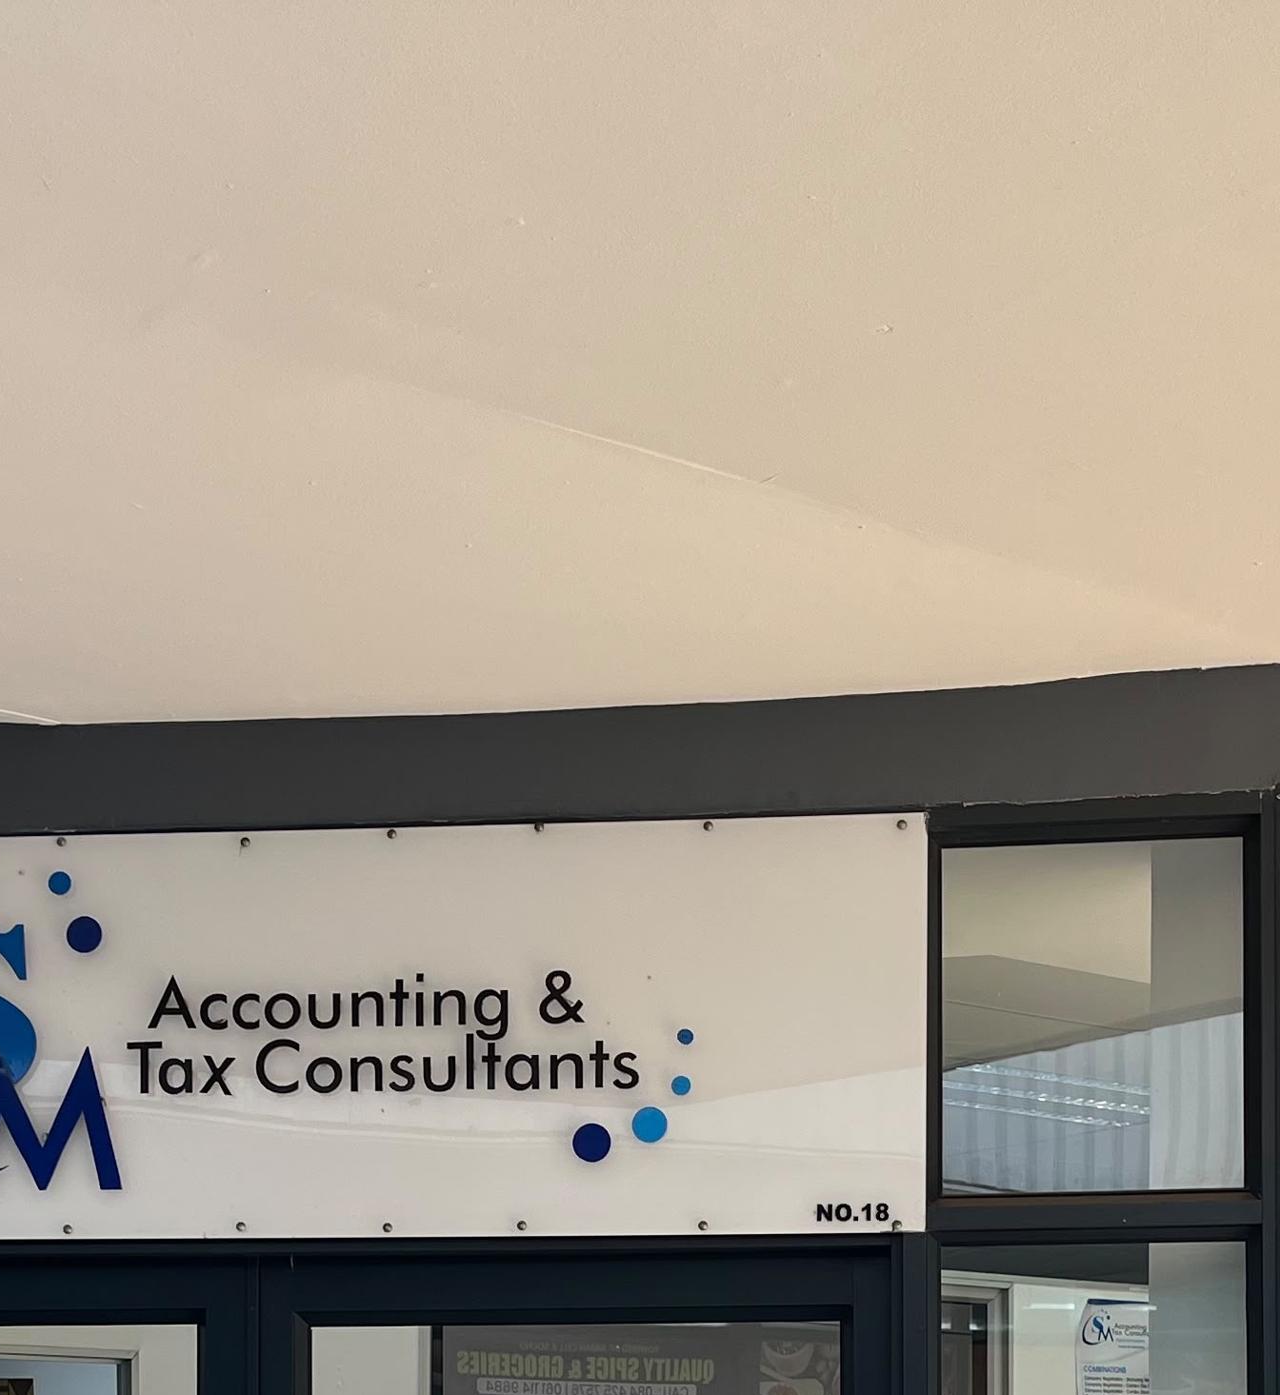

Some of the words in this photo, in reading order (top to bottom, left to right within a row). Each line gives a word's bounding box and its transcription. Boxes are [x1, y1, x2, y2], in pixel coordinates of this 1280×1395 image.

[147, 973, 509, 1041] Accounting
[538, 969, 585, 1025] &
[126, 1040, 236, 1097] Tax
[255, 1032, 640, 1094] Consultants
[816, 1203, 890, 1222] NO.18
